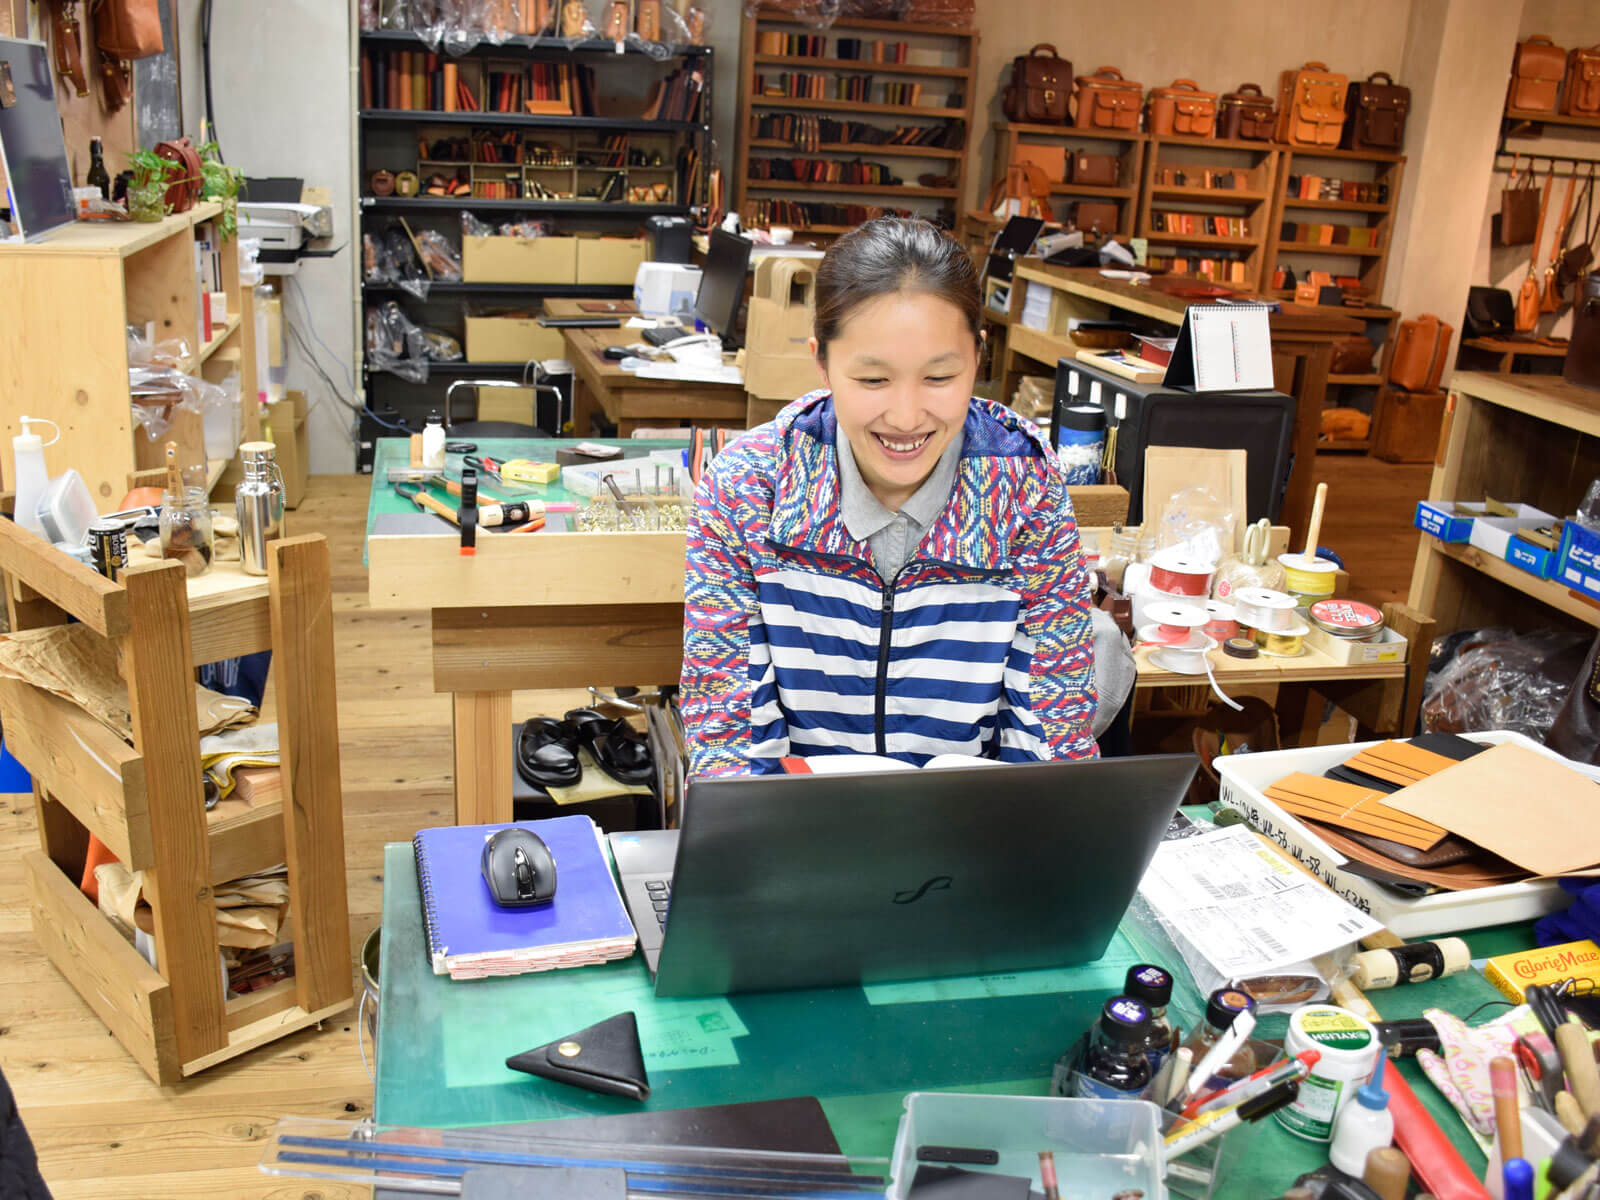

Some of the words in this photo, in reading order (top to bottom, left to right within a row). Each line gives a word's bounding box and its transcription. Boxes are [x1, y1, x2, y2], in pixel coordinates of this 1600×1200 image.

[111, 534, 121, 556] BOSS
[1513, 951, 1599, 979] CalorieMate
[1312, 1031, 1357, 1041] XYLISH
